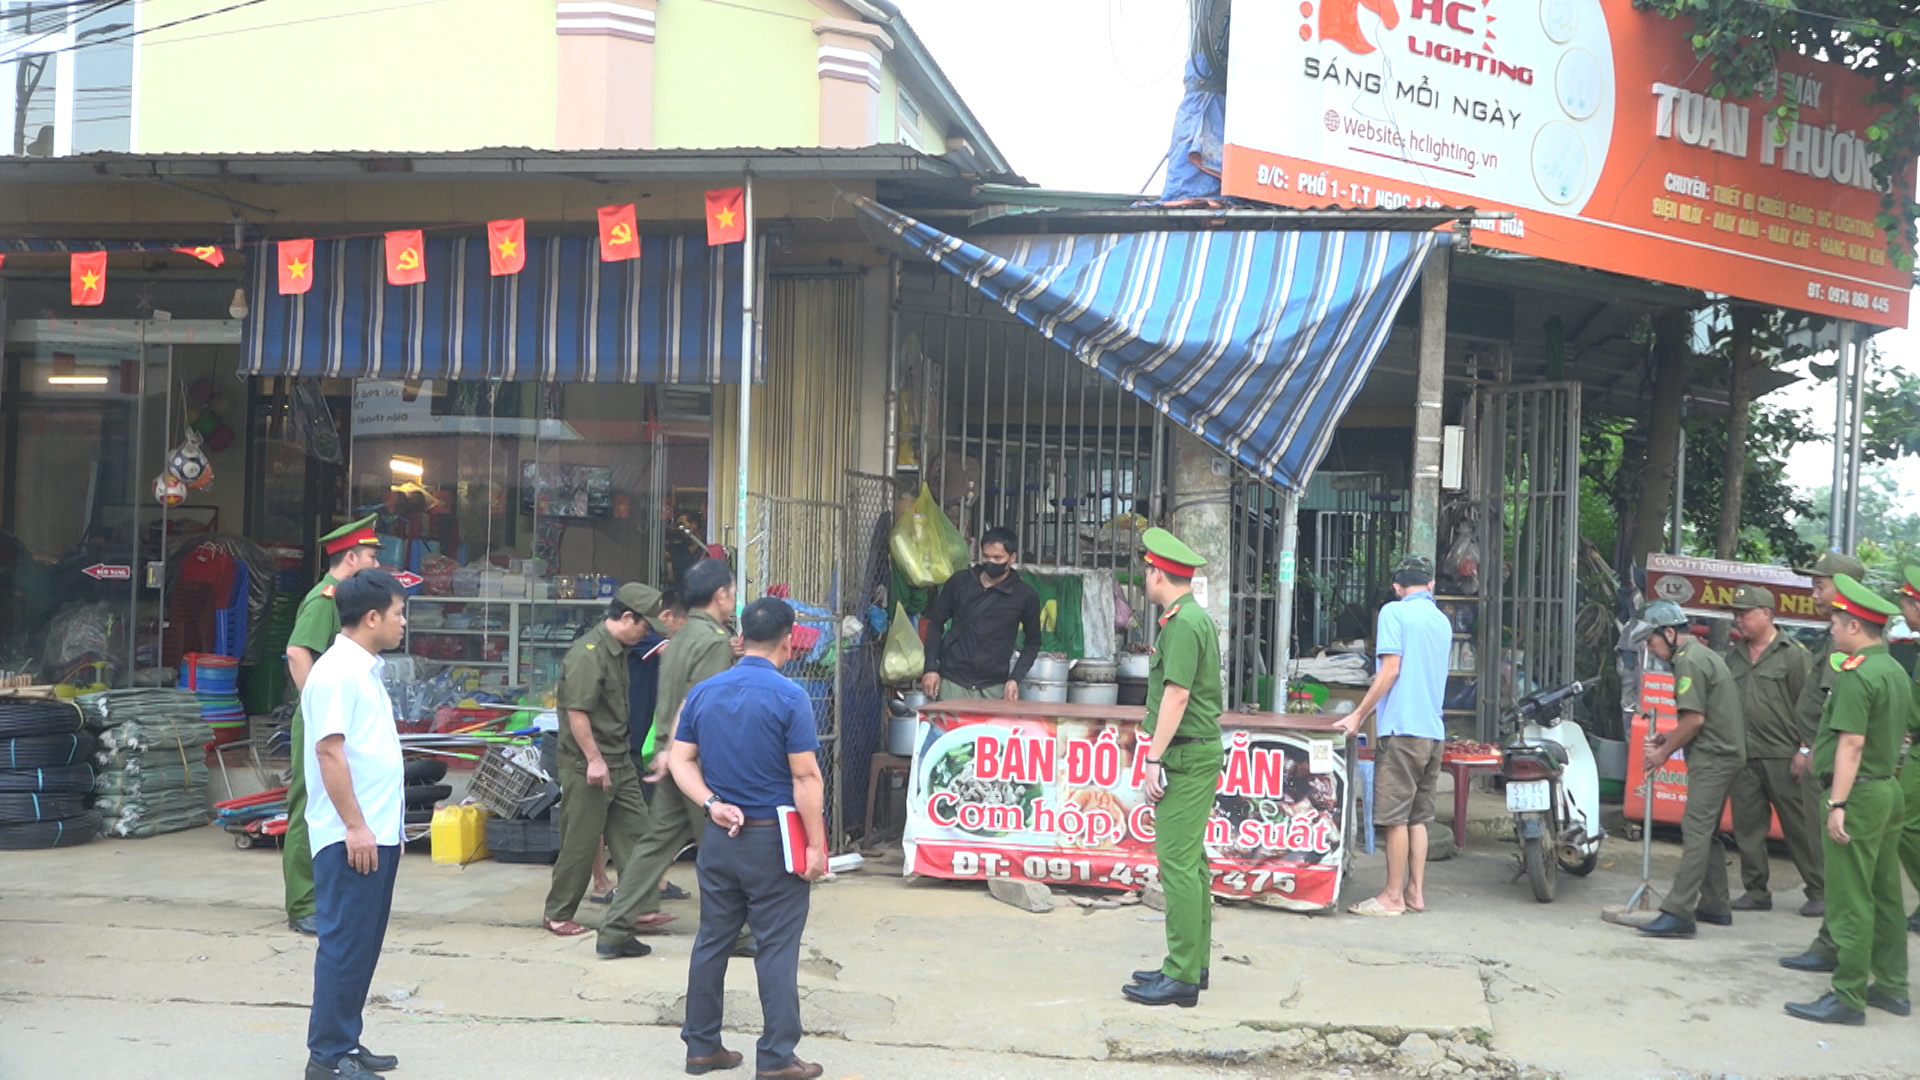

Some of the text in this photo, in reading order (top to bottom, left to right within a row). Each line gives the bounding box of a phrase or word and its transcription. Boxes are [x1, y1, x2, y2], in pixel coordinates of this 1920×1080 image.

[1410, 0, 1476, 35] HC
[1408, 35, 1534, 85] LIGHTING
[1304, 56, 1382, 94] SÁNG
[1453, 96, 1522, 129] NGÀY
[1343, 116, 1406, 148] Website:
[1257, 164, 1289, 189] Đ/C:
[1297, 170, 1328, 197] PHỐ
[1330, 180, 1338, 198] 1
[1664, 171, 1711, 200] CHUYÊN:
[1834, 213, 1875, 238] LIGHTING
[1807, 281, 1825, 300] ĐT:
[976, 727, 1055, 783] BÁN
[1067, 727, 1118, 786] ĐỒ
[1215, 731, 1285, 797] ẴN
[927, 792, 1025, 833] Cơm
[1033, 798, 1121, 845] hộp,
[1238, 811, 1329, 851] suất
[952, 851, 1011, 878] ĐT:
